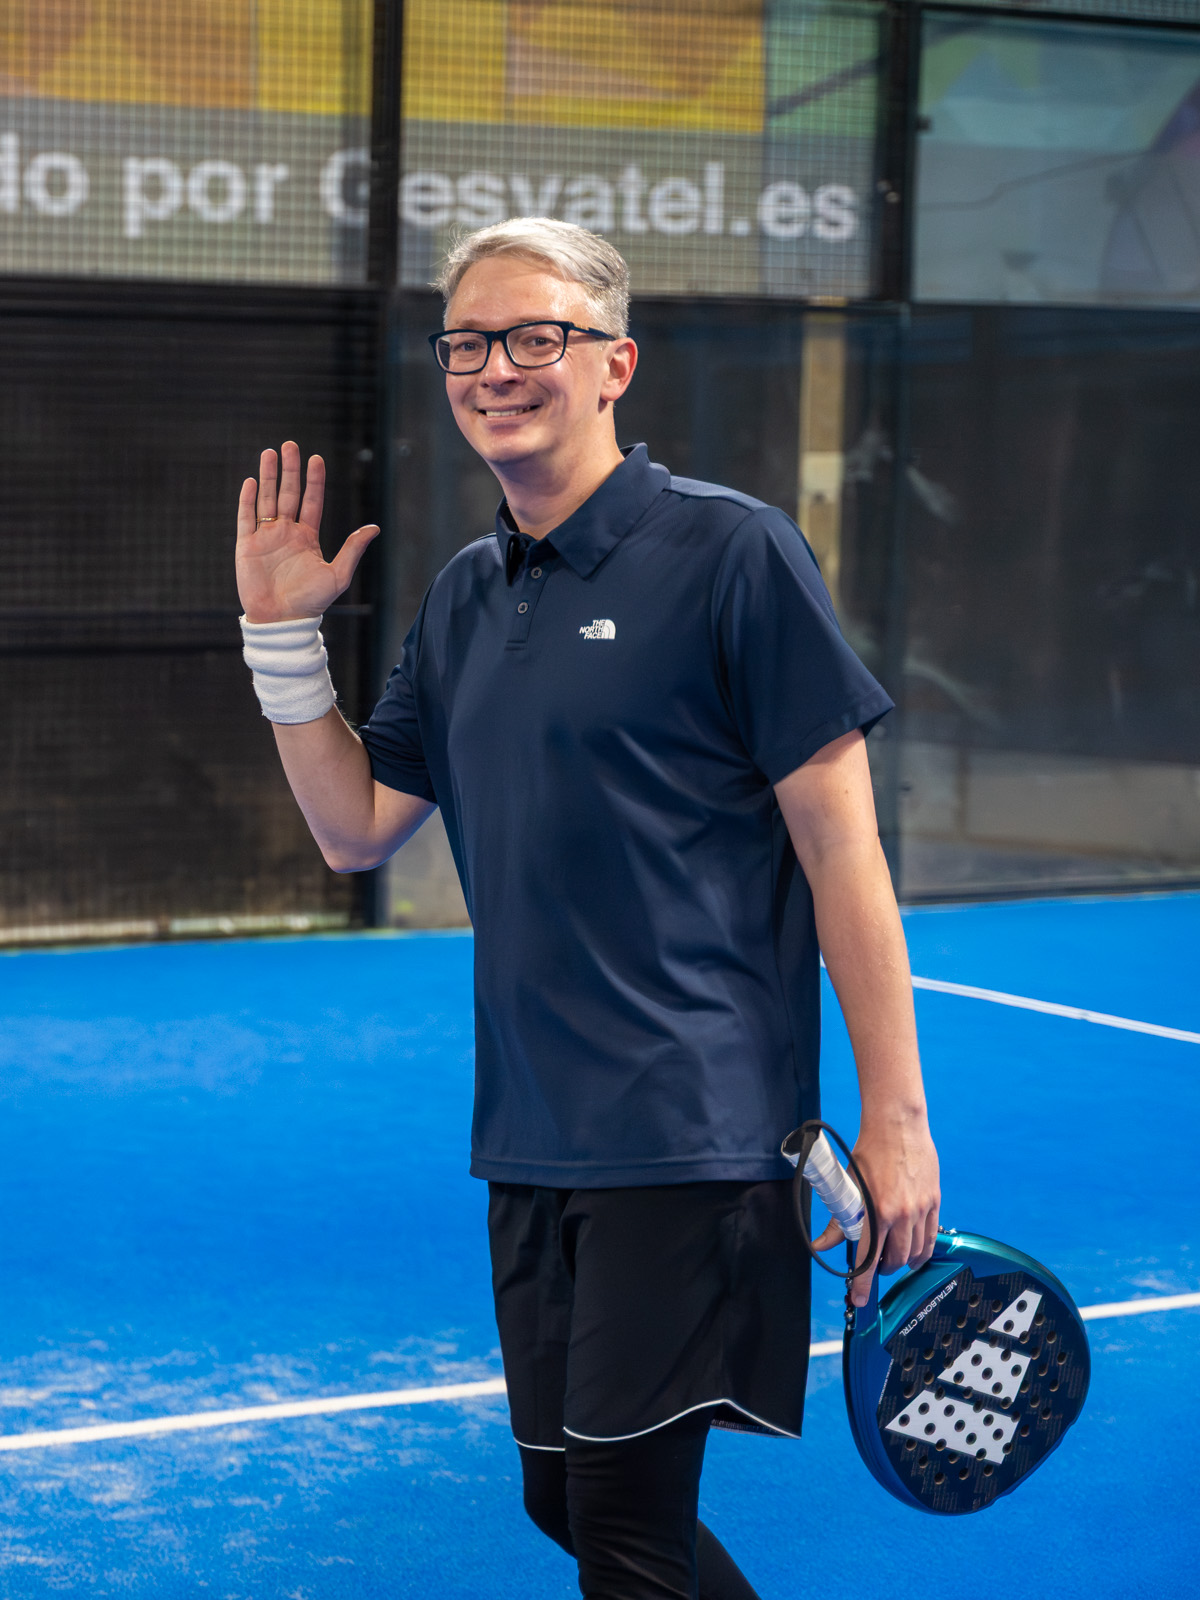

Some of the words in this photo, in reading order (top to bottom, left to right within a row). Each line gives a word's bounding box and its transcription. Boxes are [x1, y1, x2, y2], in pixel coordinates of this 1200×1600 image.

[124, 155, 288, 239] por
[579, 626, 604, 634] NORTH
[592, 619, 606, 627] THE
[584, 631, 603, 640] FACE
[916, 1279, 958, 1322] METALBONE
[899, 1318, 918, 1337] CTRL
